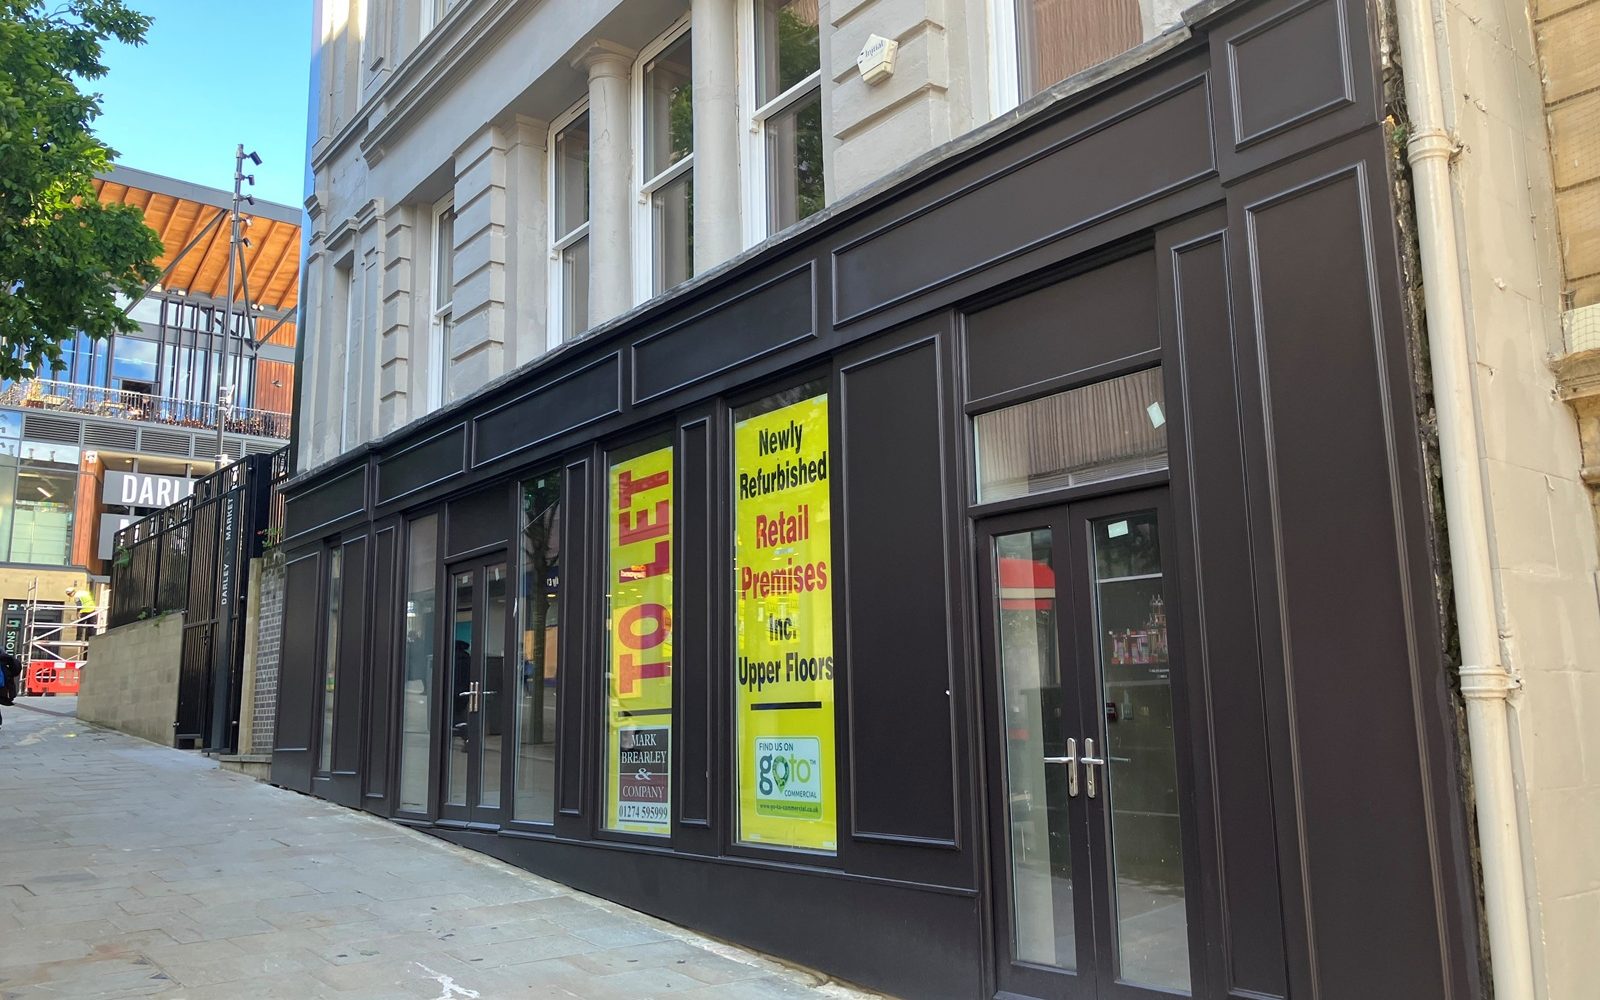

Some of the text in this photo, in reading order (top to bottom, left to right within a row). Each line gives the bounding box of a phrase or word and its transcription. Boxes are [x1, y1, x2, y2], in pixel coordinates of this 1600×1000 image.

[759, 420, 803, 456] Newly
[121, 474, 198, 508] DARL
[740, 451, 827, 500] Refurbished
[618, 470, 669, 583] LET
[756, 504, 809, 549] Retail
[221, 498, 234, 605] DARLEY MARKET
[741, 558, 828, 600] Premises
[618, 603, 672, 694] TO
[738, 652, 835, 692] Upper Floors
[621, 751, 667, 764] BREARLEY
[631, 733, 657, 747] MARK
[759, 742, 794, 751] FIND US ON
[634, 767, 652, 781] &
[622, 785, 665, 799] COMPANY
[784, 789, 817, 799] COMMERCIAL
[619, 805, 668, 819] 01274 595999
